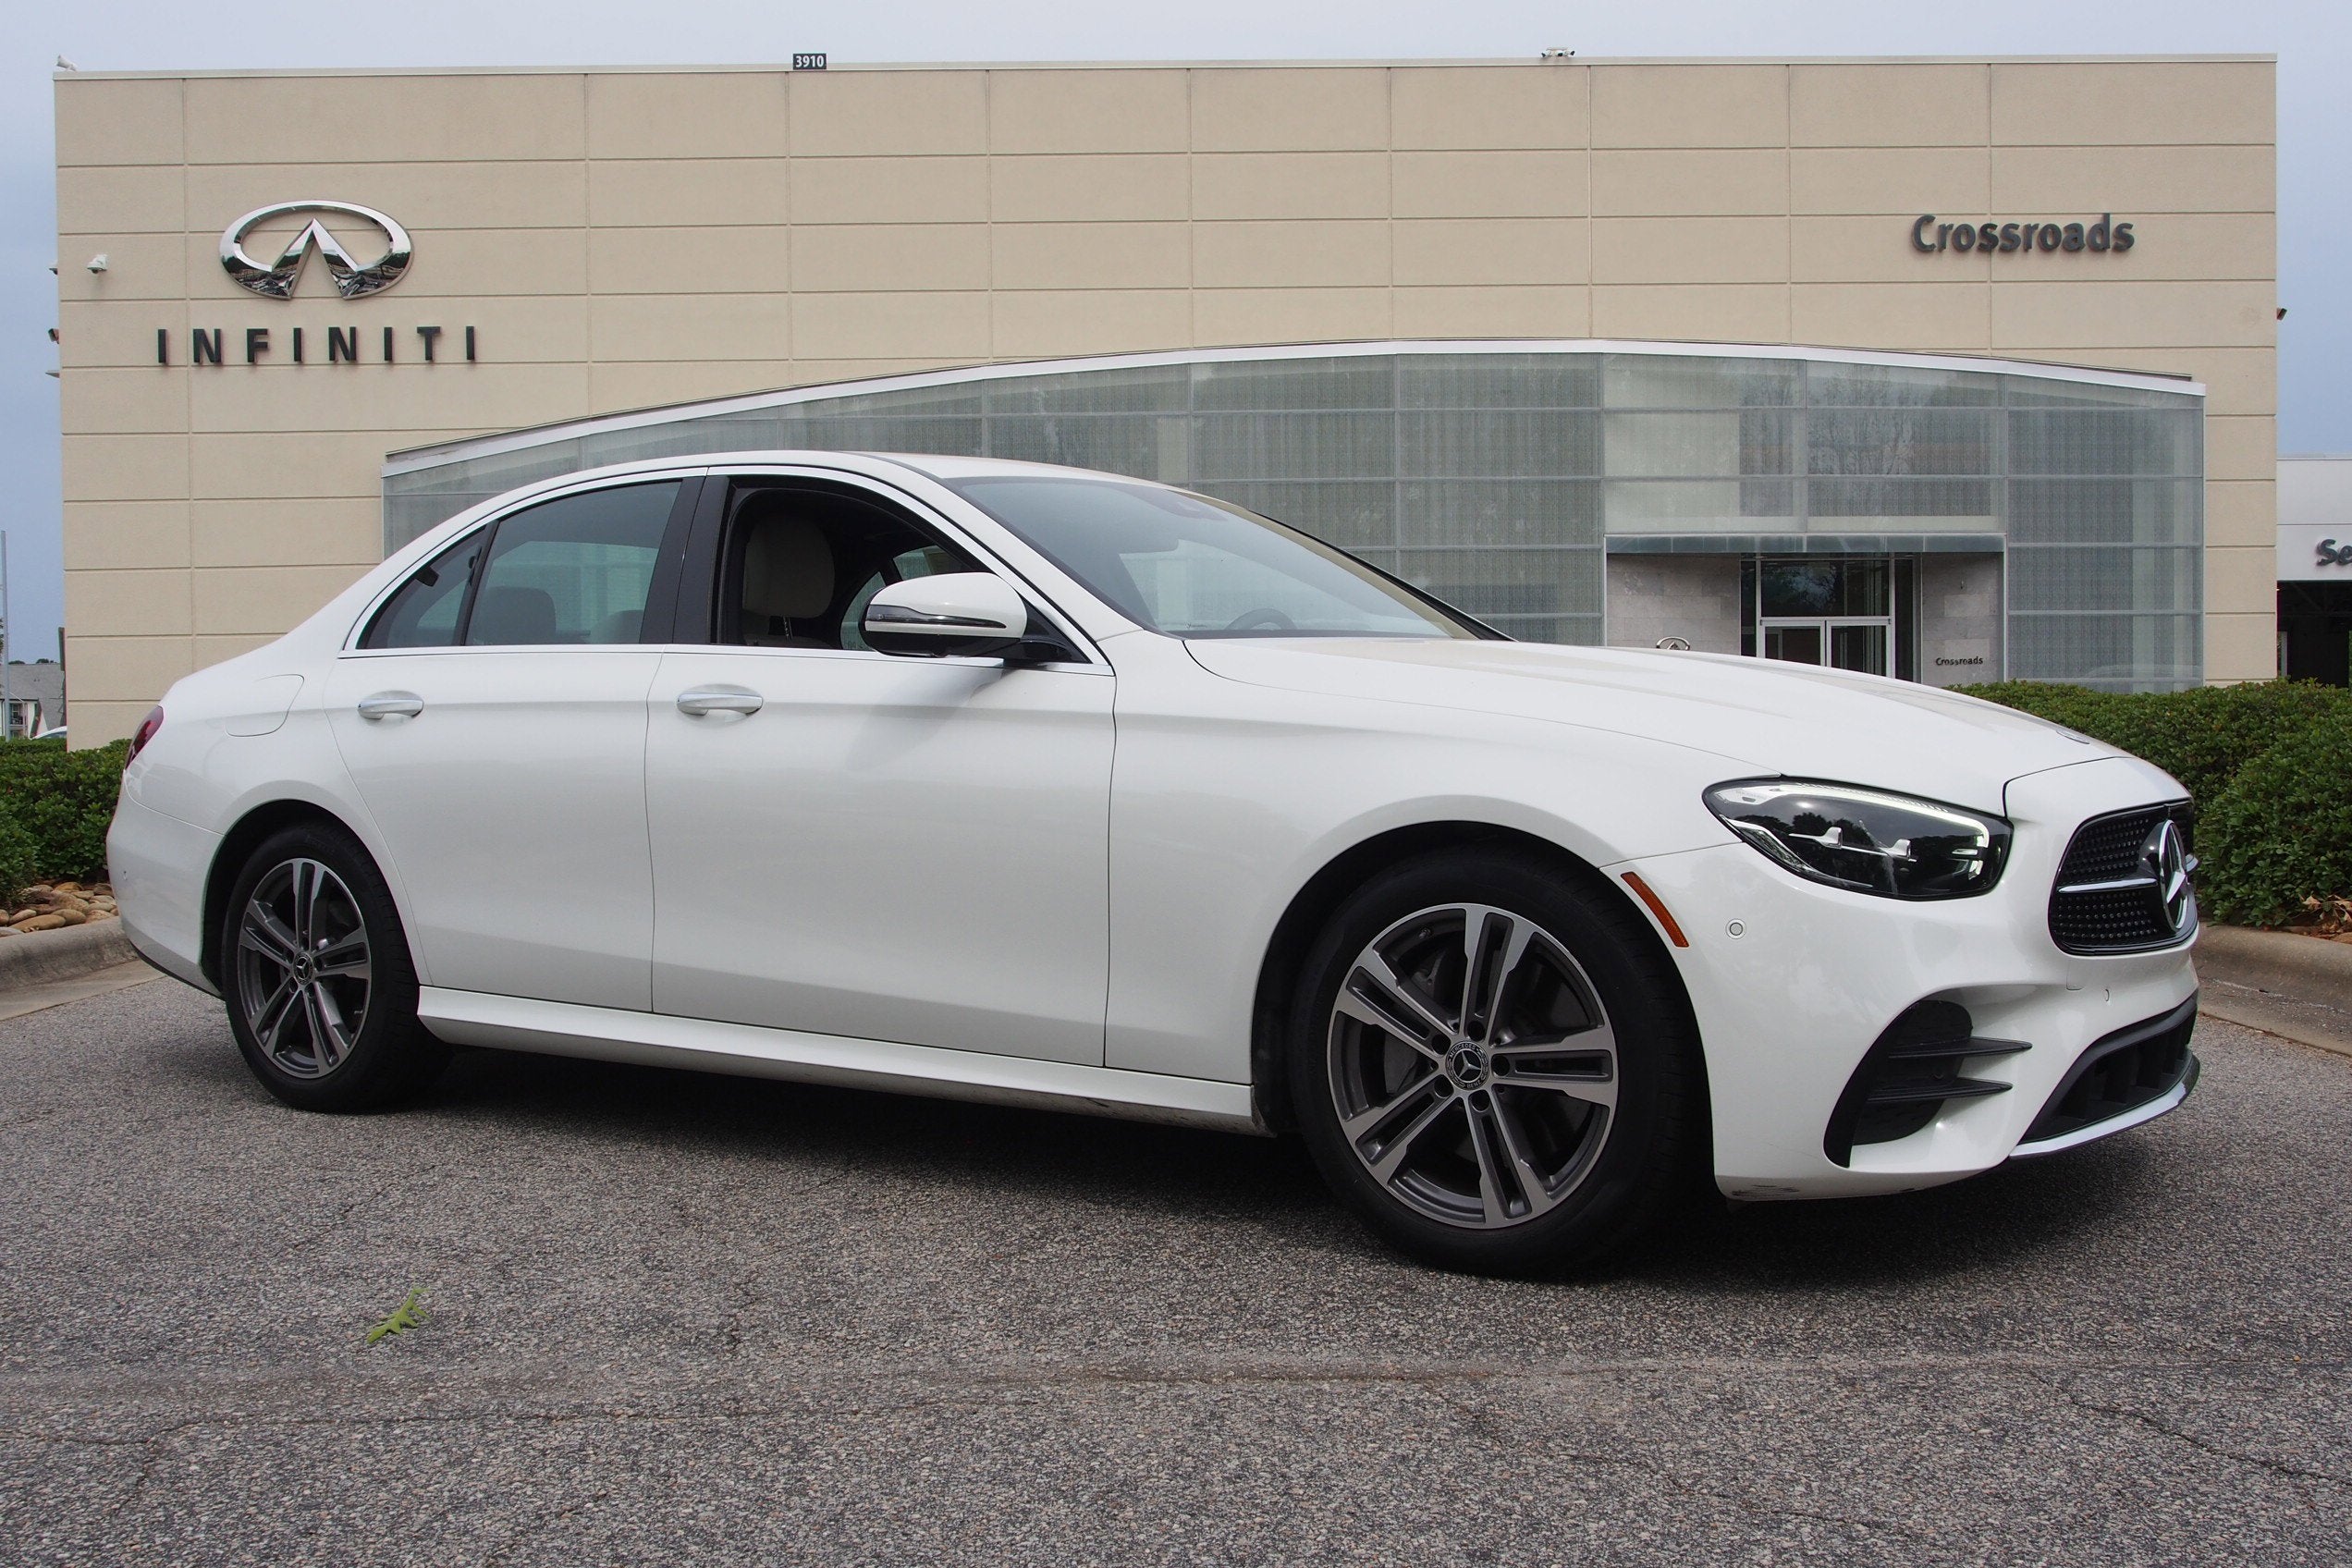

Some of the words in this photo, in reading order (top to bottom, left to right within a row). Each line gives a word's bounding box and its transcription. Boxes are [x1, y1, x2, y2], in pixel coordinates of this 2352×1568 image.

[795, 55, 825, 67] 3910
[1911, 213, 2135, 252] Crossroads
[157, 325, 476, 363] INFINITI
[1935, 655, 1984, 666] Crossroads
